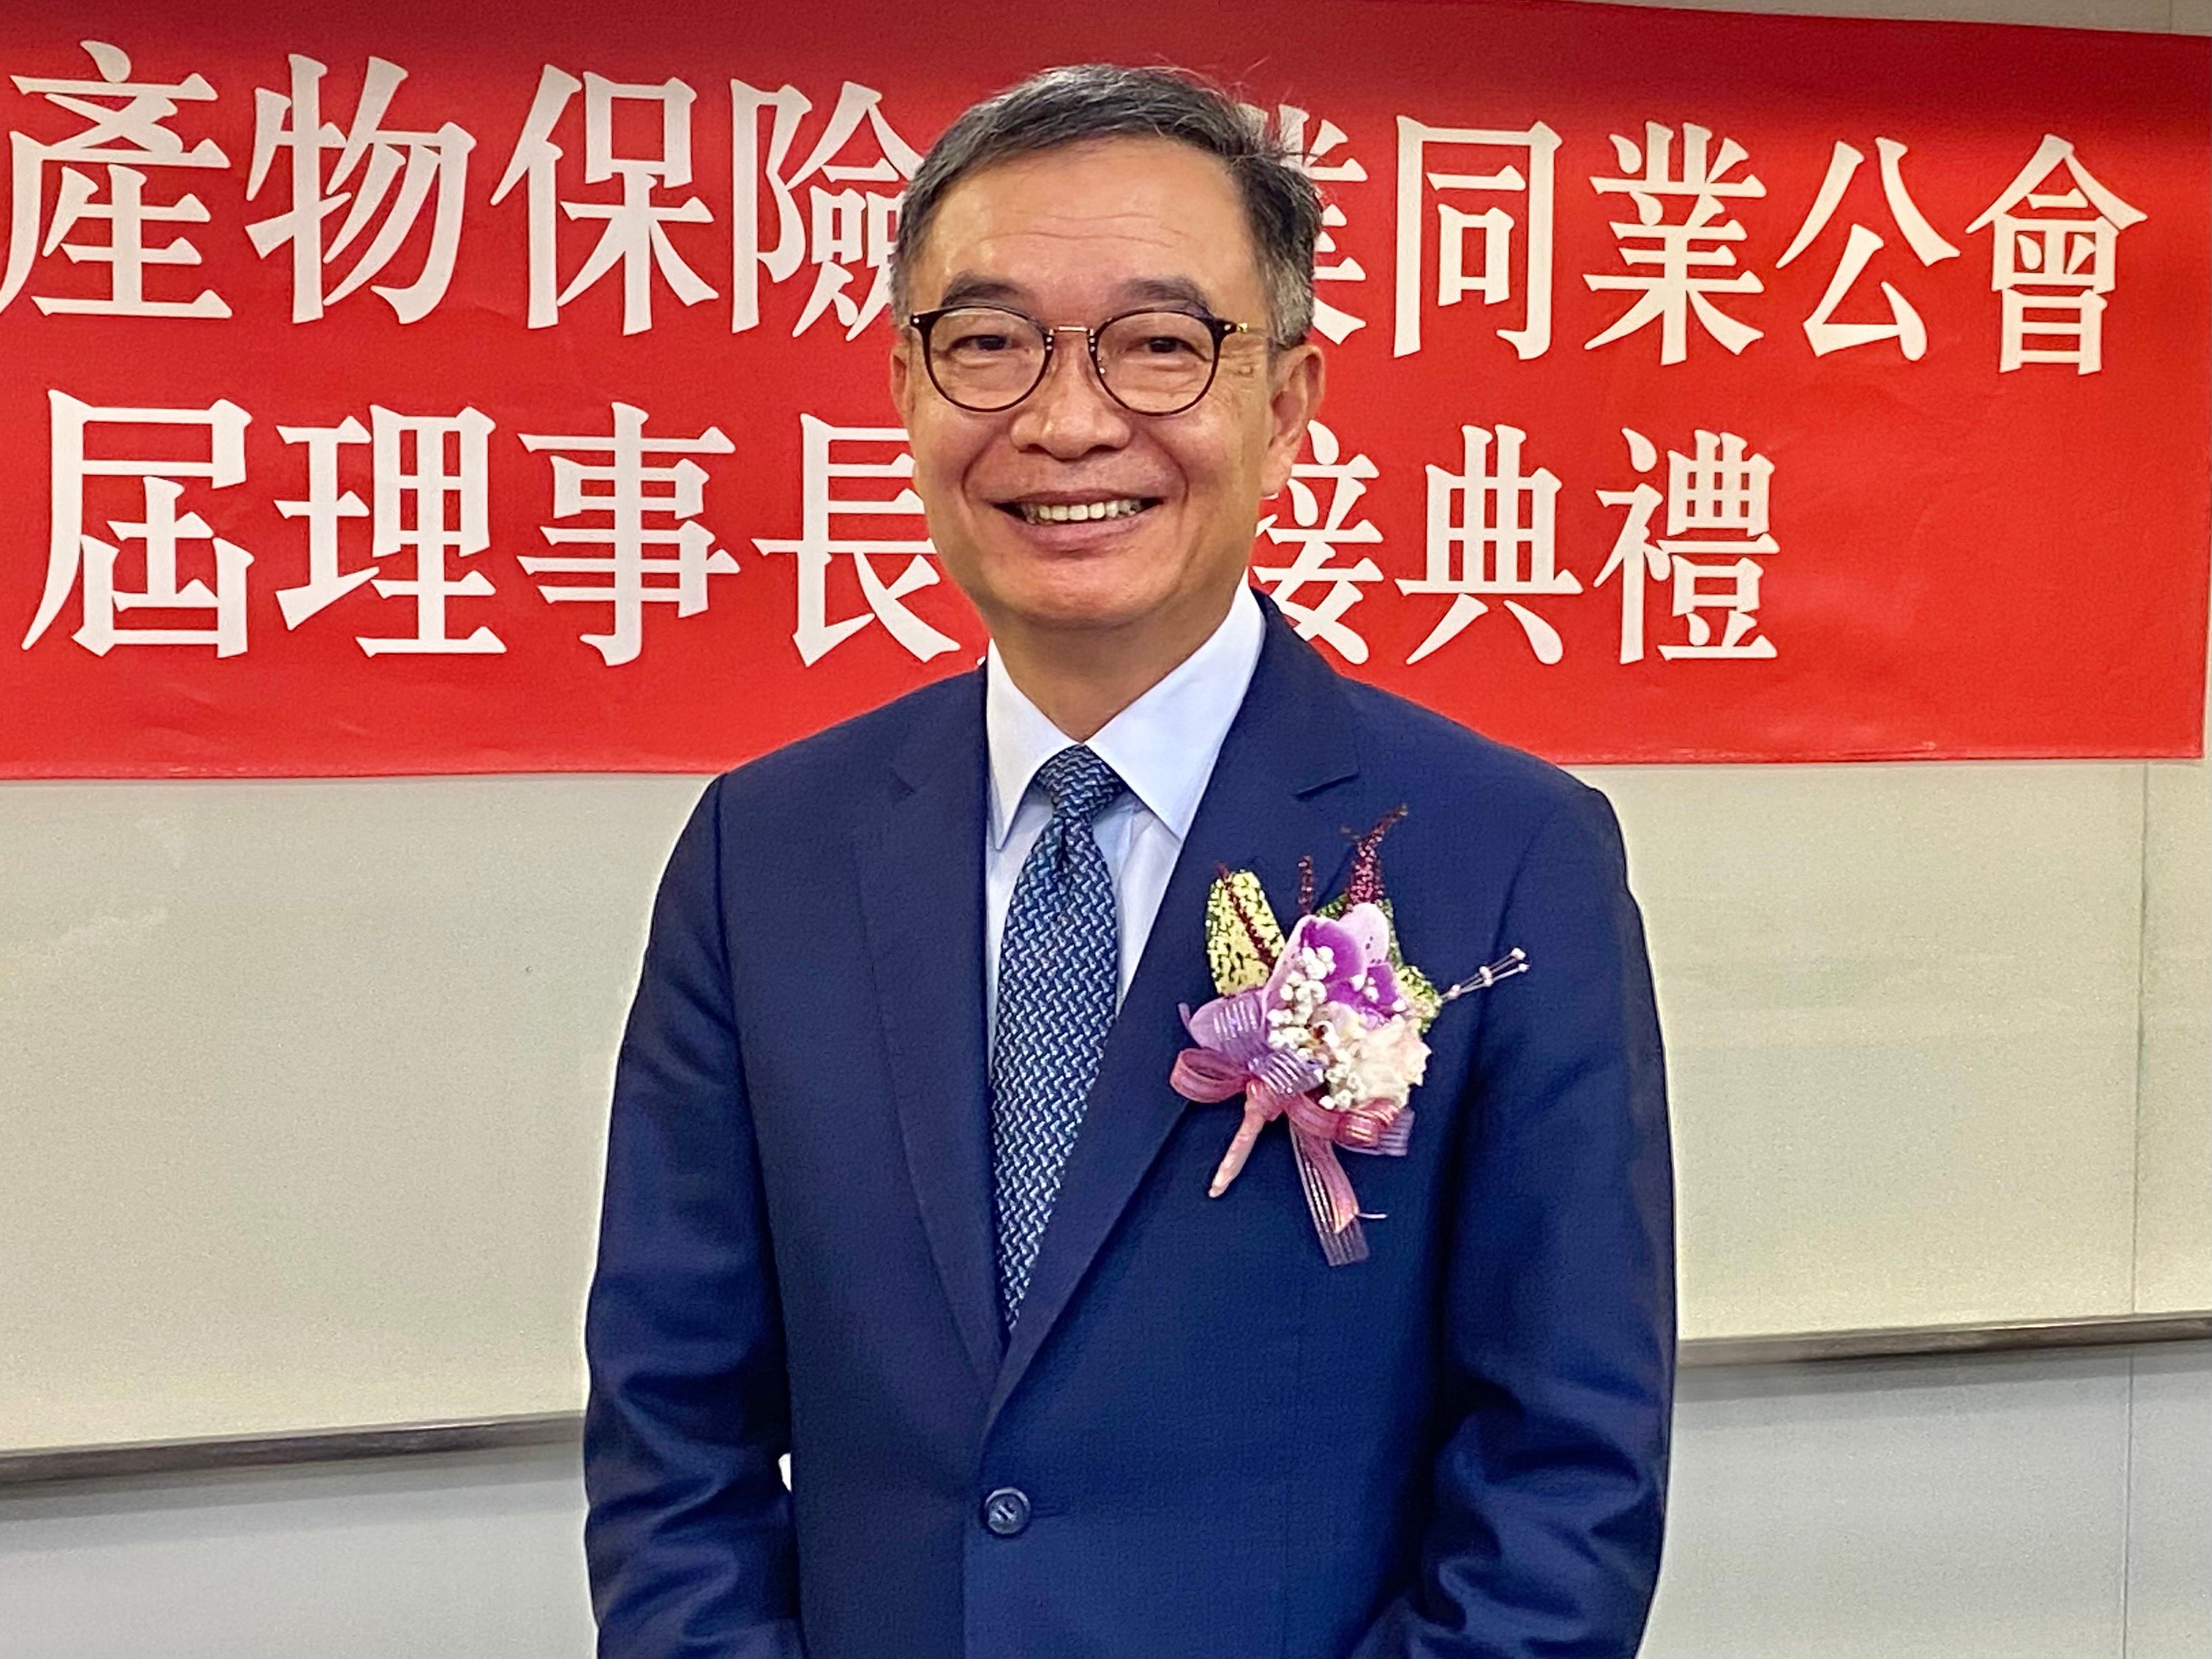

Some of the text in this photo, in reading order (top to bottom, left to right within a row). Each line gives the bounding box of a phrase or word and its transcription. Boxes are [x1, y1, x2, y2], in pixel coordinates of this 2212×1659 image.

[0, 41, 925, 341] 產物保險
[21, 390, 961, 667] 屆理事長
